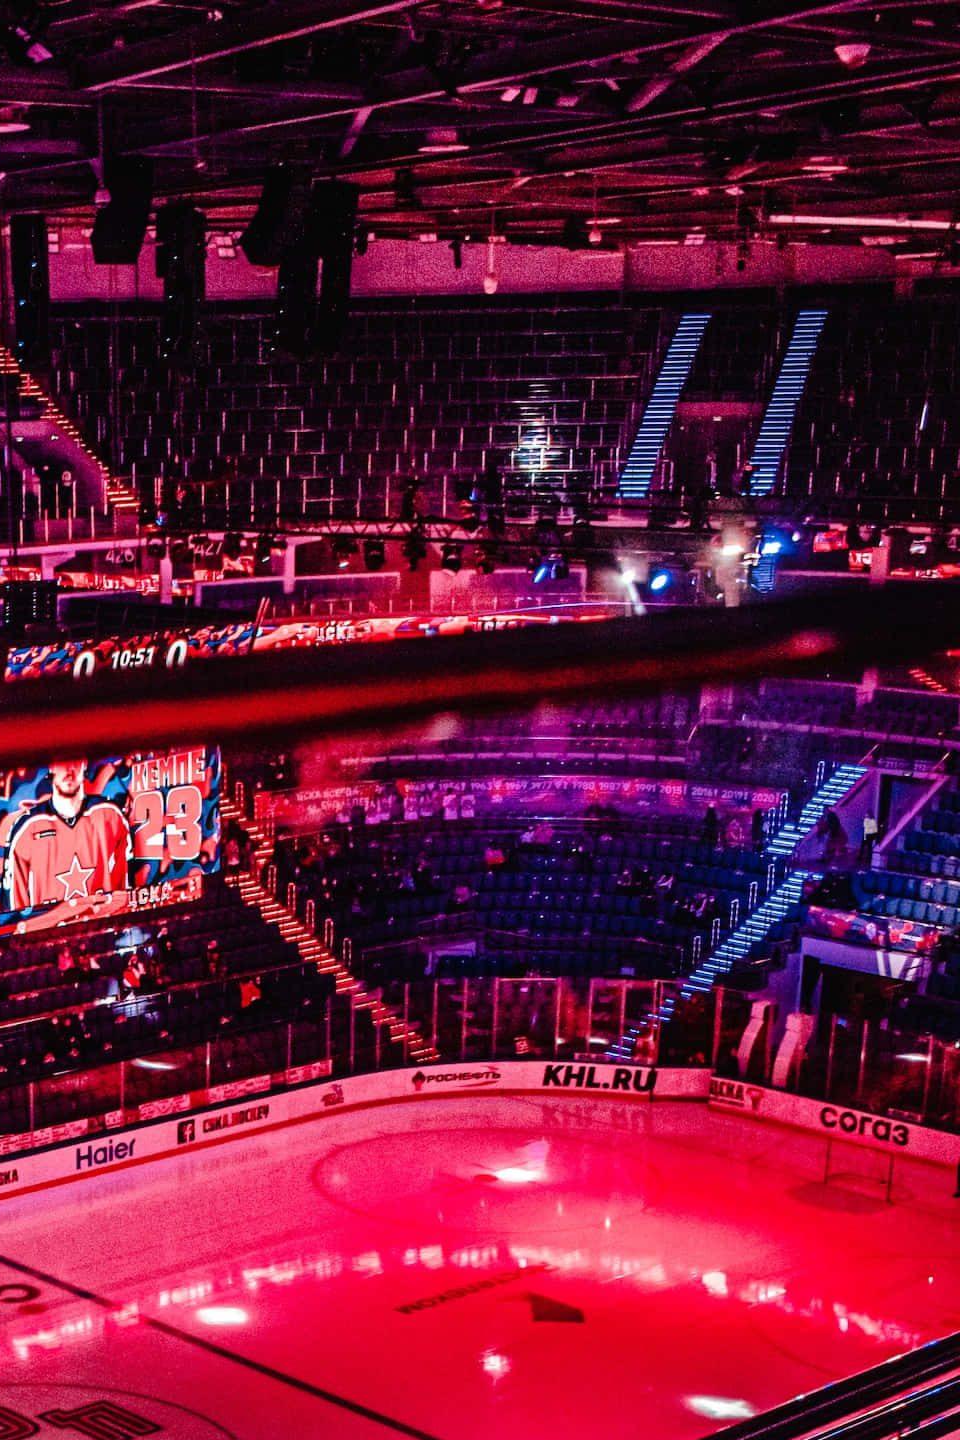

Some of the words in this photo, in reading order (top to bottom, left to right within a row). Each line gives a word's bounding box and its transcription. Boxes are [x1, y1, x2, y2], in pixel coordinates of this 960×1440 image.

[111, 648, 155, 669] 10:51
[132, 749, 206, 793] КЕМПЕ
[132, 785, 203, 861] 23
[426, 1070, 501, 1084] РОСНЕФТЬ
[542, 1065, 659, 1092] KHL.RU
[76, 1138, 136, 1170] Haier
